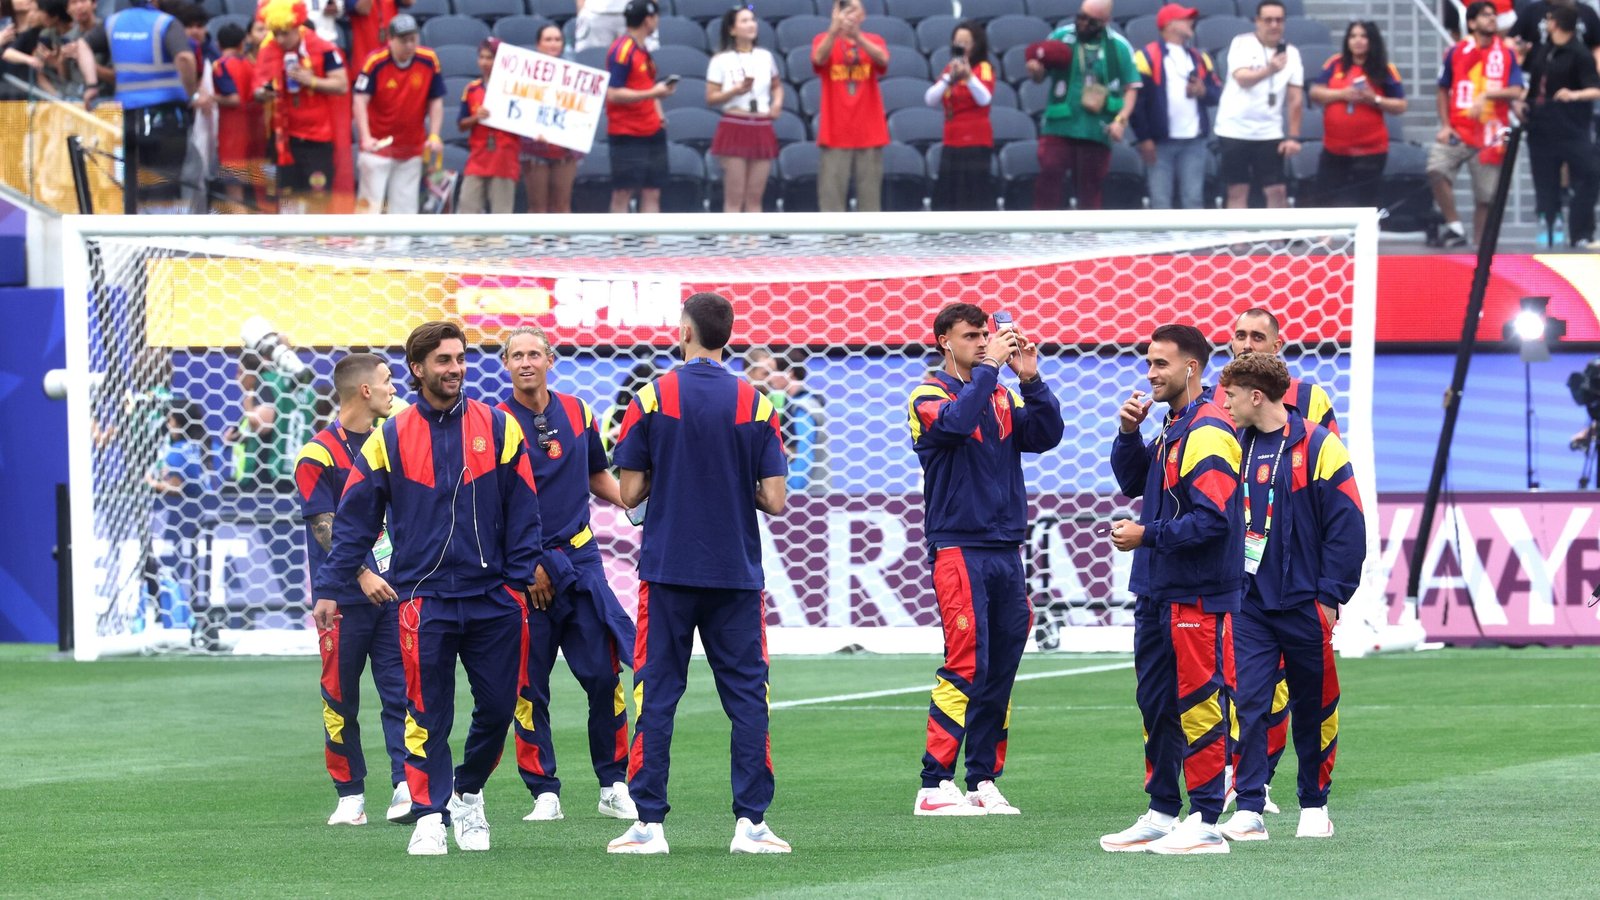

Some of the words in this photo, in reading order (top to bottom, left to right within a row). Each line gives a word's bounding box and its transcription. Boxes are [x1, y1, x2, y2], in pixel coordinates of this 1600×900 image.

[501, 54, 519, 74] NO
[521, 59, 556, 82] NEED
[507, 99, 522, 119] IS
[536, 106, 566, 129] HERE
[554, 278, 681, 327] SPAIN
